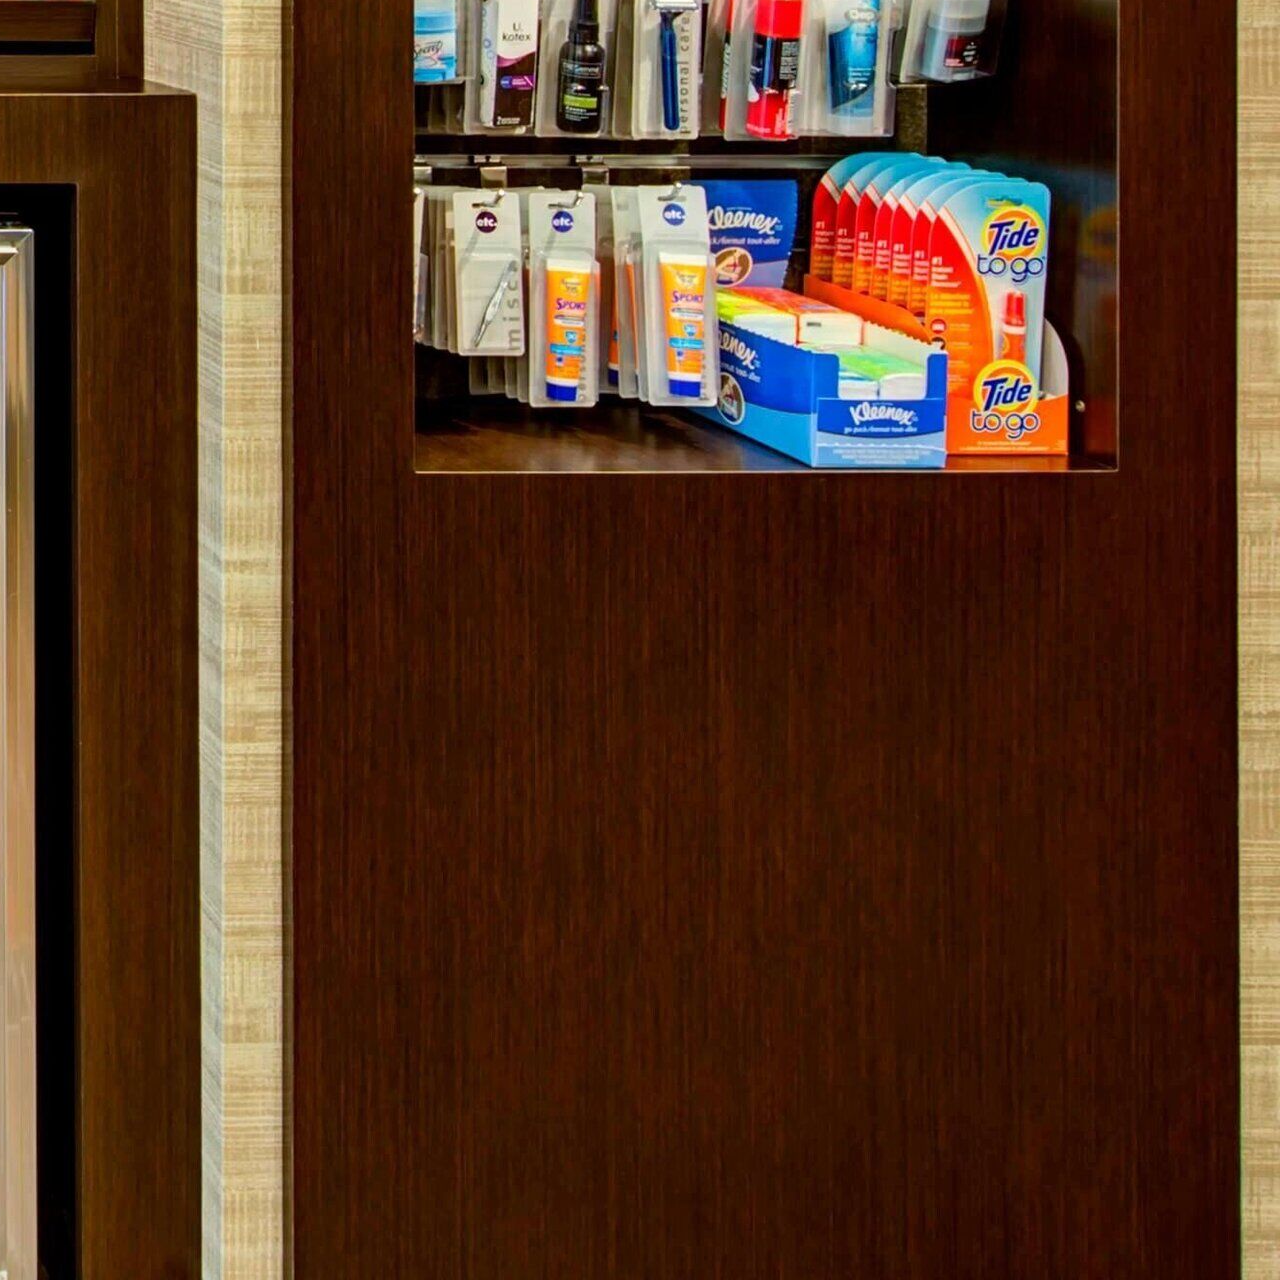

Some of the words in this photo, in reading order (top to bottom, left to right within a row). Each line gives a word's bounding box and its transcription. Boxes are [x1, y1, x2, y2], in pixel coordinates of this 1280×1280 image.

[502, 29, 532, 44] kotex
[680, 15, 690, 54] care
[680, 62, 692, 135] personal
[475, 216, 499, 229] etc.
[552, 216, 575, 228] etc.
[663, 208, 686, 220] etc.
[988, 219, 1040, 256] Tide
[976, 253, 1007, 276] to
[1010, 256, 1045, 283] go
[505, 280, 522, 351] misc
[981, 376, 1033, 412] Tide
[849, 401, 914, 425] Kleenex
[970, 411, 1002, 433] to
[1005, 413, 1040, 440] go
